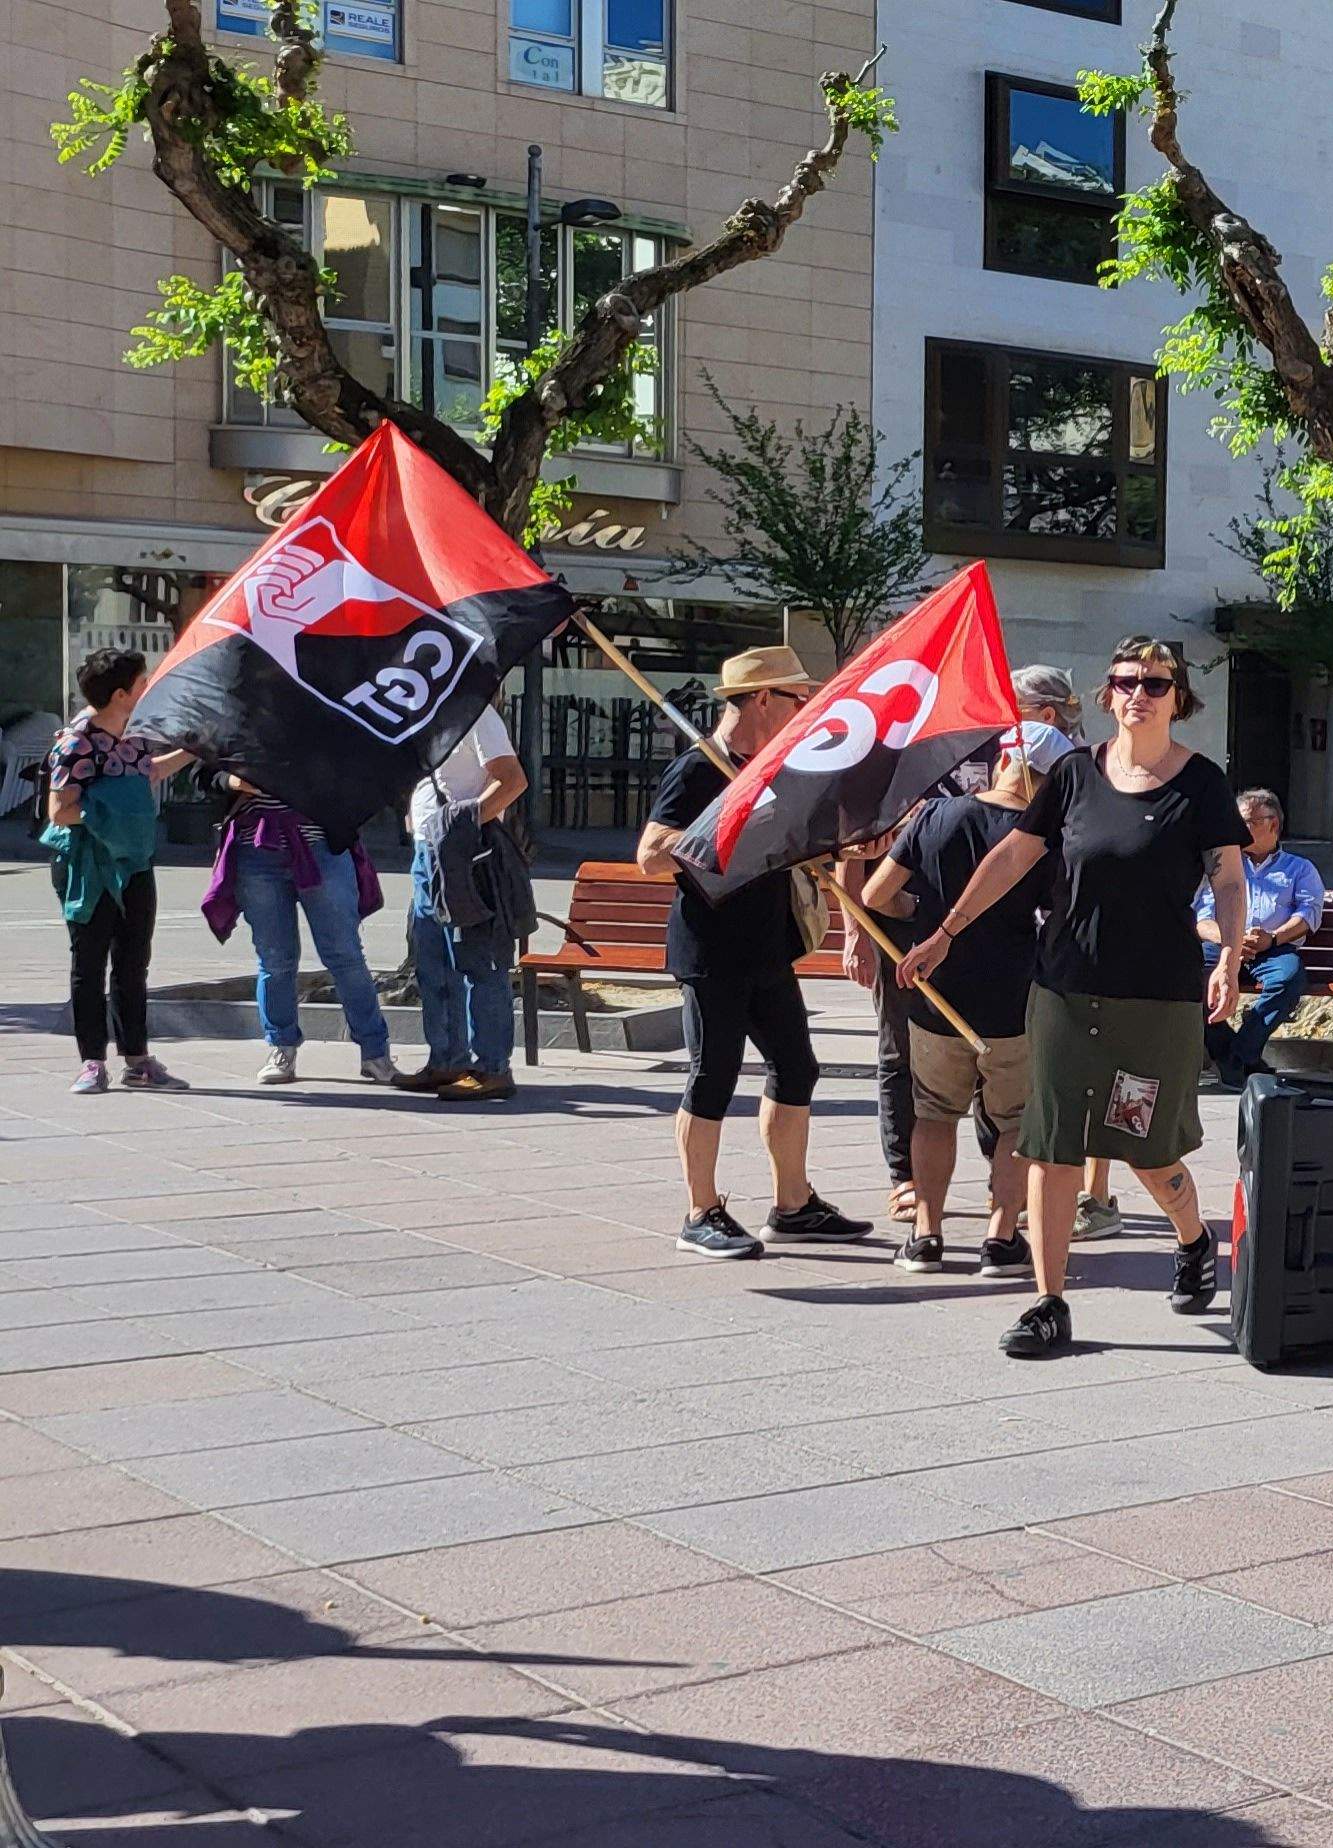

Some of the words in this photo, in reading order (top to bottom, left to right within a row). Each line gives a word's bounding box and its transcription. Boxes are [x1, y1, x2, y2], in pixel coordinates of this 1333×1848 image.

[349, 13, 391, 27] REALE
[343, 630, 453, 723] CGT
[753, 660, 939, 809] CG
